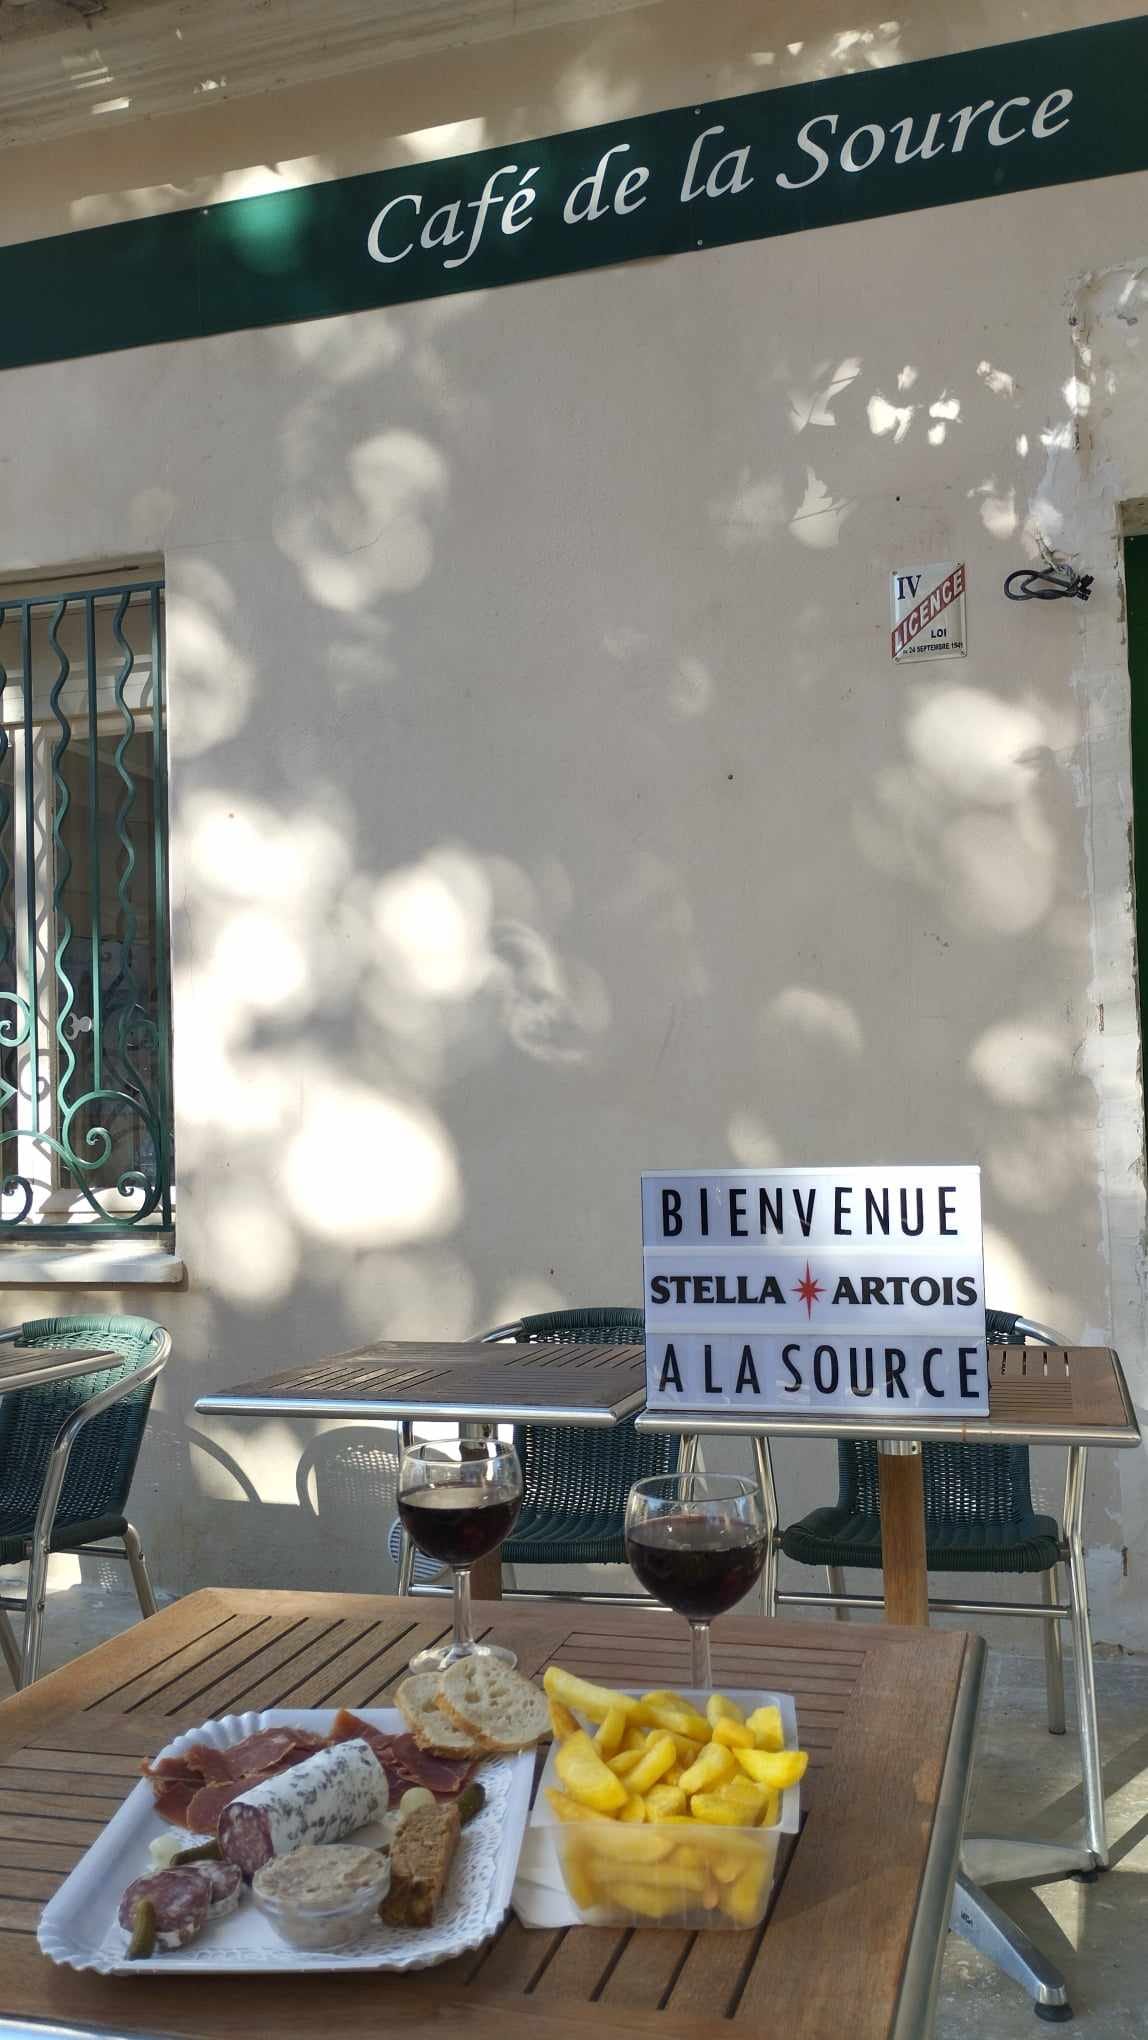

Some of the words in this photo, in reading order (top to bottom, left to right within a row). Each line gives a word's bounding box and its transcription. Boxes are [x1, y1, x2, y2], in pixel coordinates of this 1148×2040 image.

[367, 164, 541, 268] Café
[564, 143, 650, 224] de
[680, 126, 754, 201] la
[776, 88, 1074, 189] Source
[897, 575, 921, 600] IV
[895, 570, 962, 655] LICENCE
[931, 628, 946, 638] LOI
[917, 642, 950, 652] SEPTEMBRE
[661, 1186, 958, 1237] BIENVENUE
[651, 1275, 787, 1305] STELLA
[831, 1276, 978, 1306] ARTOIS
[658, 1343, 684, 1393] A
[704, 1344, 761, 1394] LA
[781, 1343, 980, 1399] SOURCE
